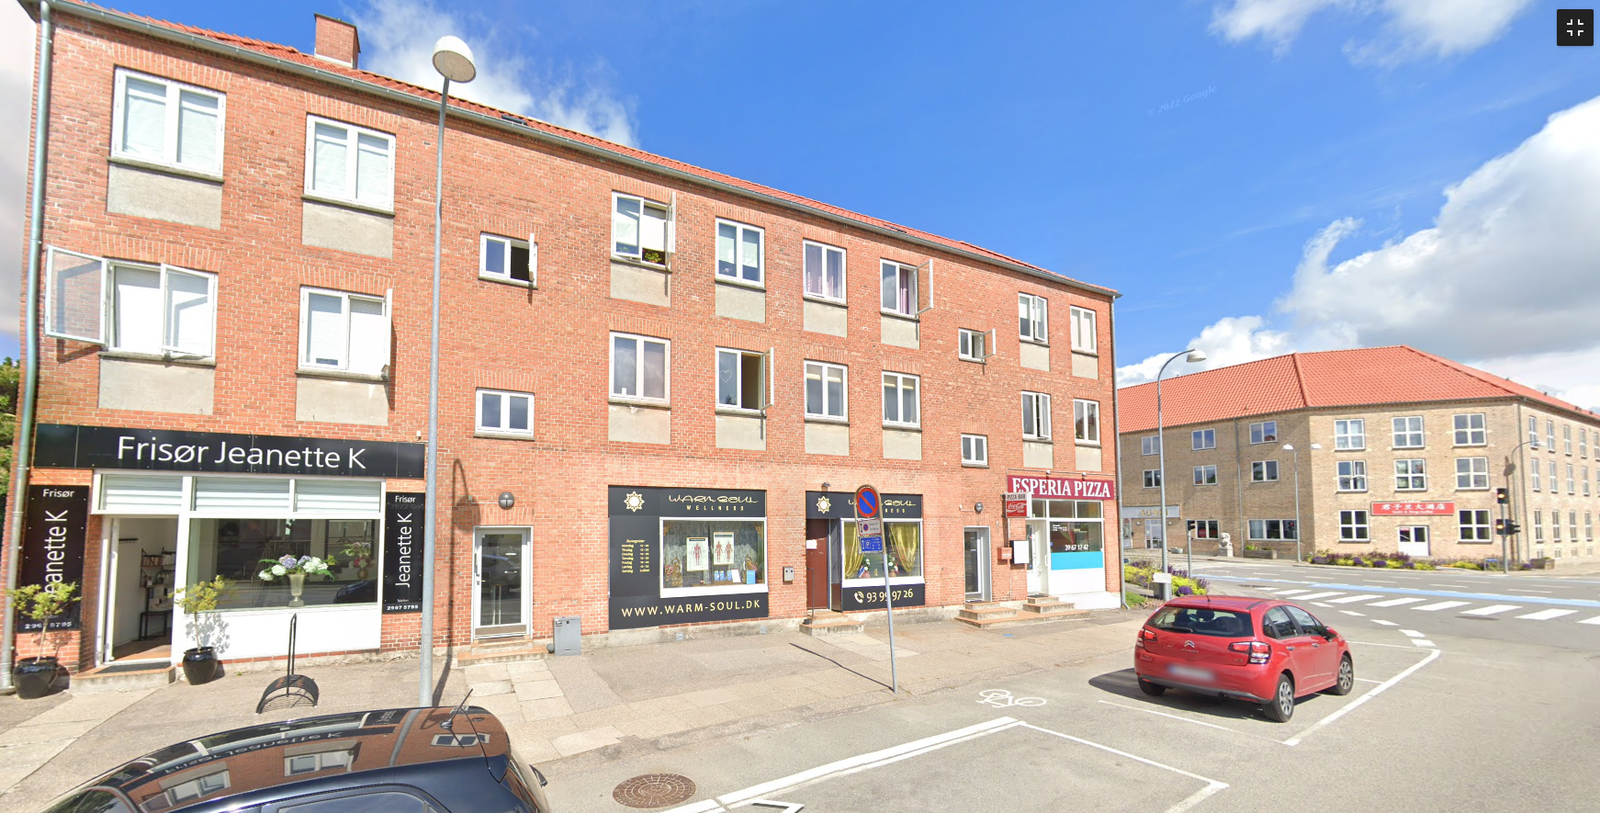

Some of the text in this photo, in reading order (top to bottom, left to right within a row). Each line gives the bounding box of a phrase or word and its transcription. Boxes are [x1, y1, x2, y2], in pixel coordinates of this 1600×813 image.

[117, 436, 367, 469] Frisør Jeanette K
[42, 488, 75, 498] Frisør
[1012, 477, 1111, 498] ESPERIA PIZZA
[395, 495, 416, 503] Frisør
[44, 510, 68, 521] K
[397, 513, 412, 523] K
[44, 526, 67, 597] eanette
[395, 526, 412, 588] Jeanette
[866, 591, 877, 603] 93
[891, 590, 901, 601] 97
[903, 588, 914, 598] 26
[621, 599, 760, 618] WWW.WARM-SOUL.DK
